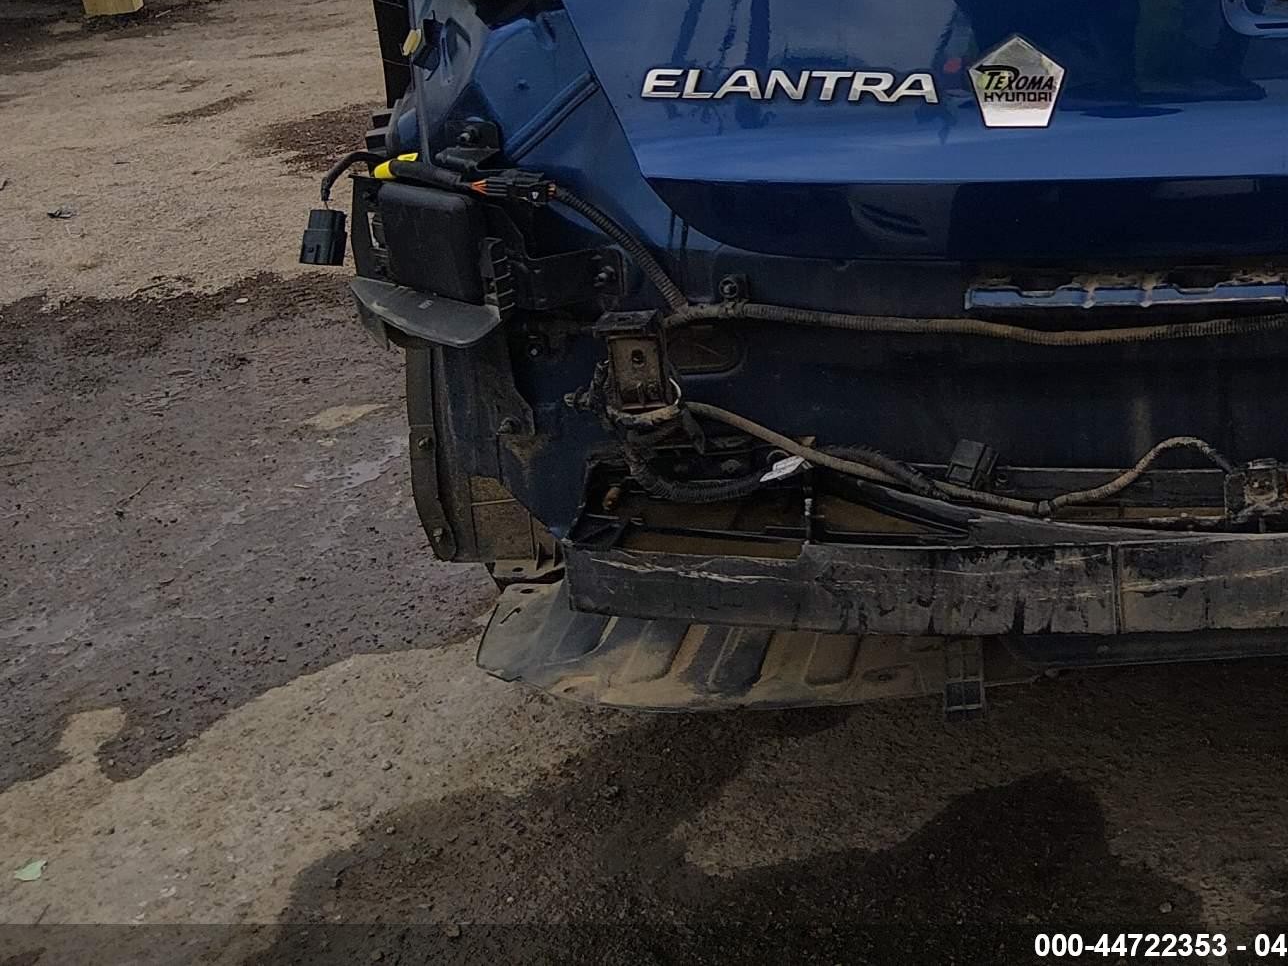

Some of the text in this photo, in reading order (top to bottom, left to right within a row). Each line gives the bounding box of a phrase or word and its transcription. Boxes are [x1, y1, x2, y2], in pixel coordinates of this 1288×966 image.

[641, 68, 938, 103] ELANTRA
[979, 68, 1055, 90] TEXOMA
[984, 92, 1053, 102] HYUNDAI
